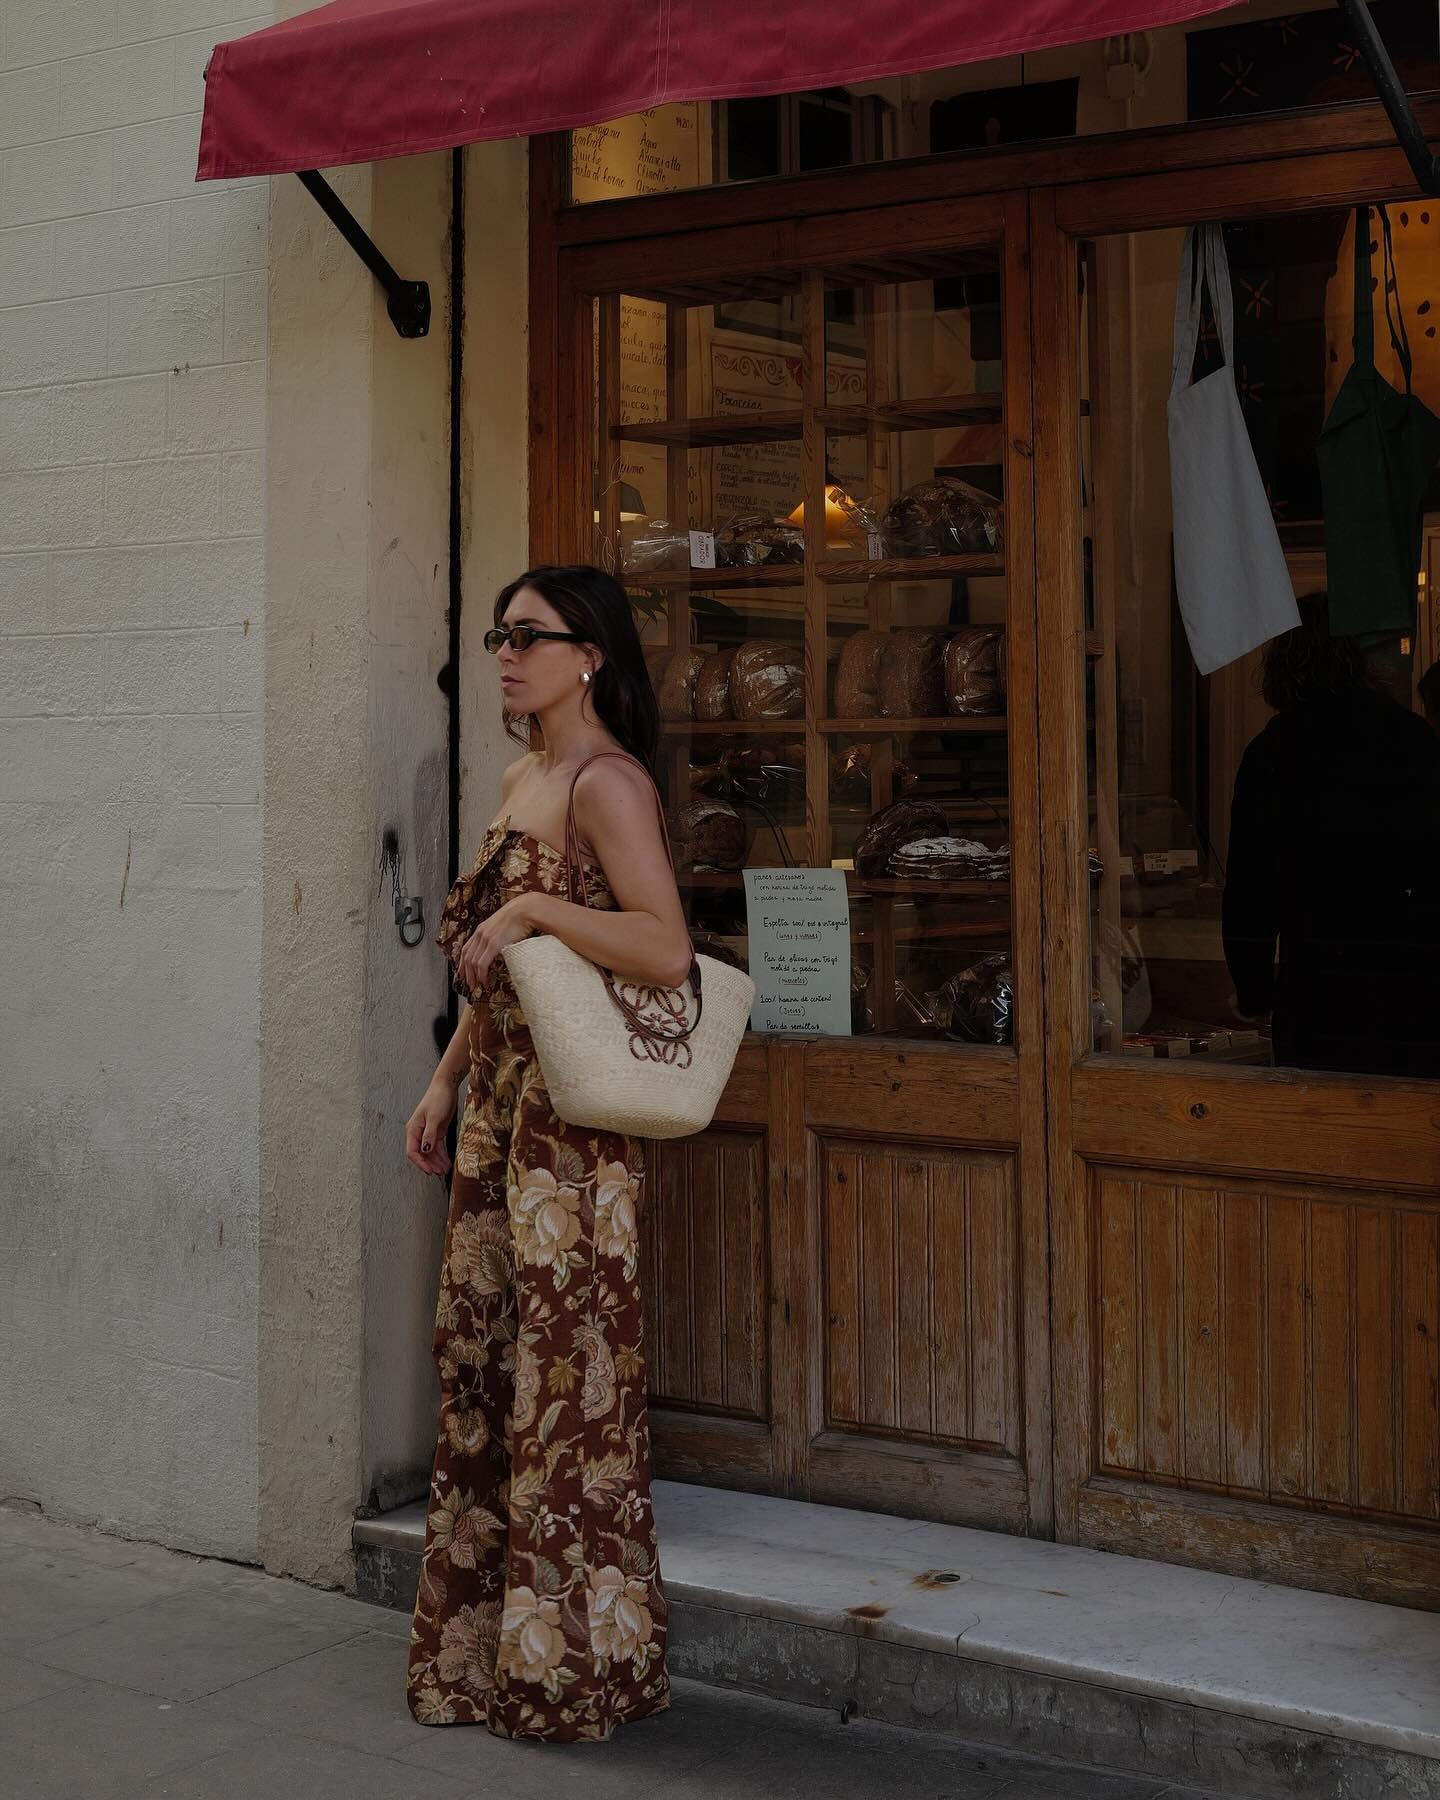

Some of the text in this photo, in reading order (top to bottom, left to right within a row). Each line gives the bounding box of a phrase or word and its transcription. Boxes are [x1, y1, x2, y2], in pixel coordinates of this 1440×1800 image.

[753, 874, 772, 888] panes
[763, 917, 789, 929] Espelta
[822, 917, 848, 931] integral
[764, 951, 776, 962] Pan
[778, 954, 786, 962] de
[789, 953, 808, 963] olivas
[822, 955, 838, 966] trigo
[766, 1019, 820, 1031] Pan de semillas
